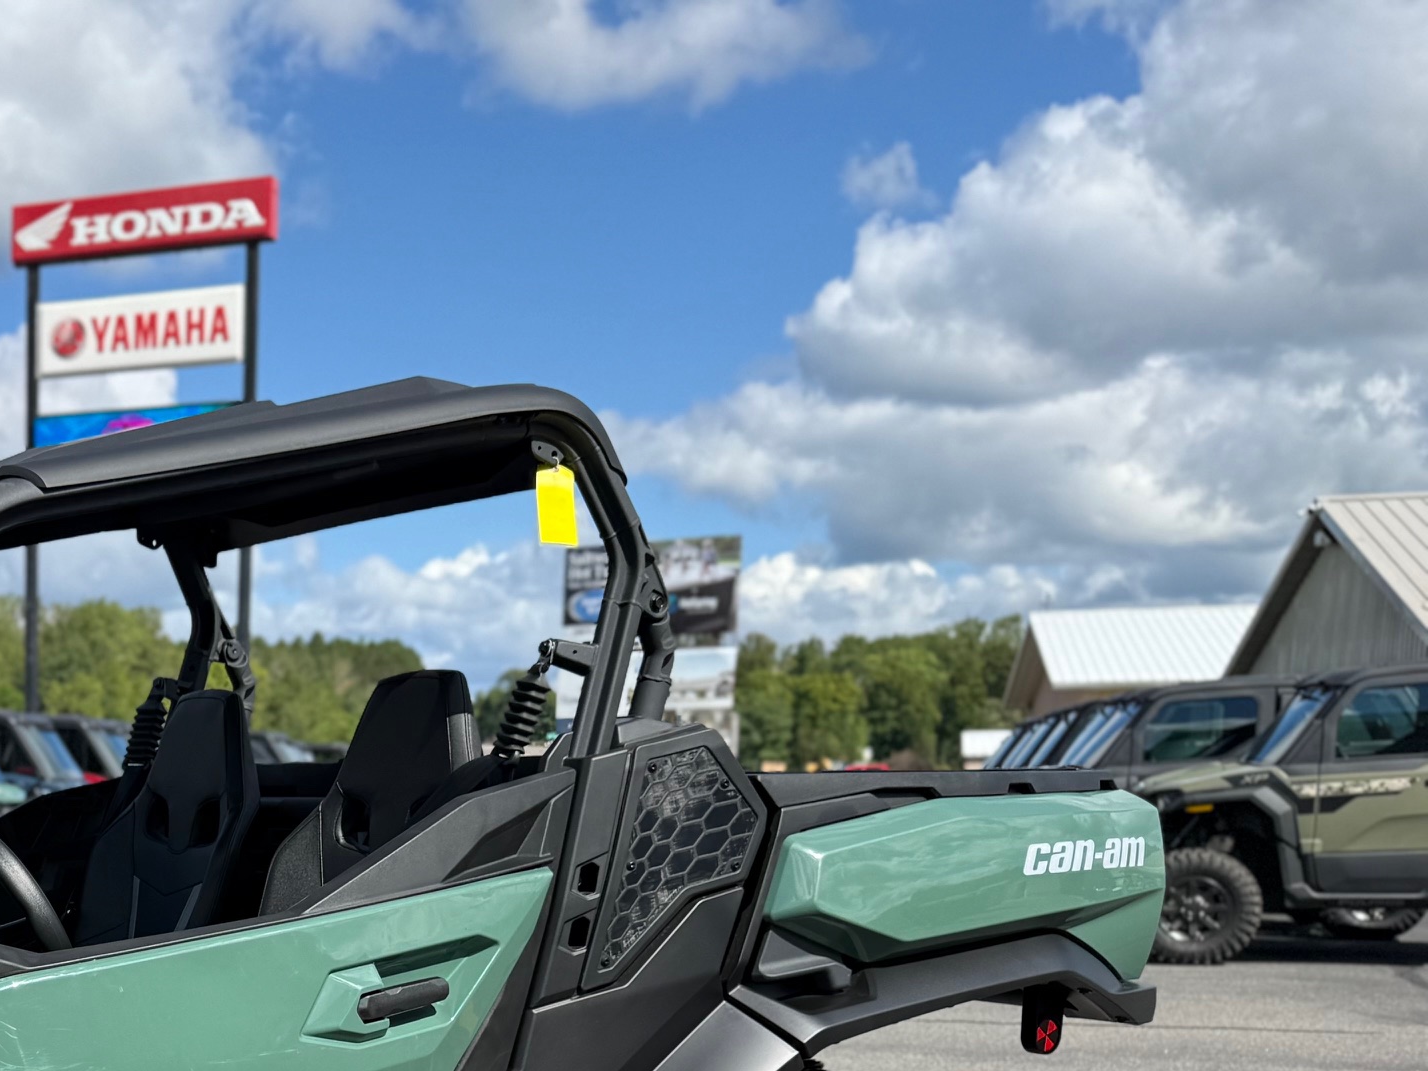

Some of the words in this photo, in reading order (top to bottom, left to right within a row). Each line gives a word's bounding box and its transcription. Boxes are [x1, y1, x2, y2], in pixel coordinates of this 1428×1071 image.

[70, 198, 265, 246] HONDA
[92, 305, 229, 353] YAMAHA
[1023, 836, 1145, 876] can-am
